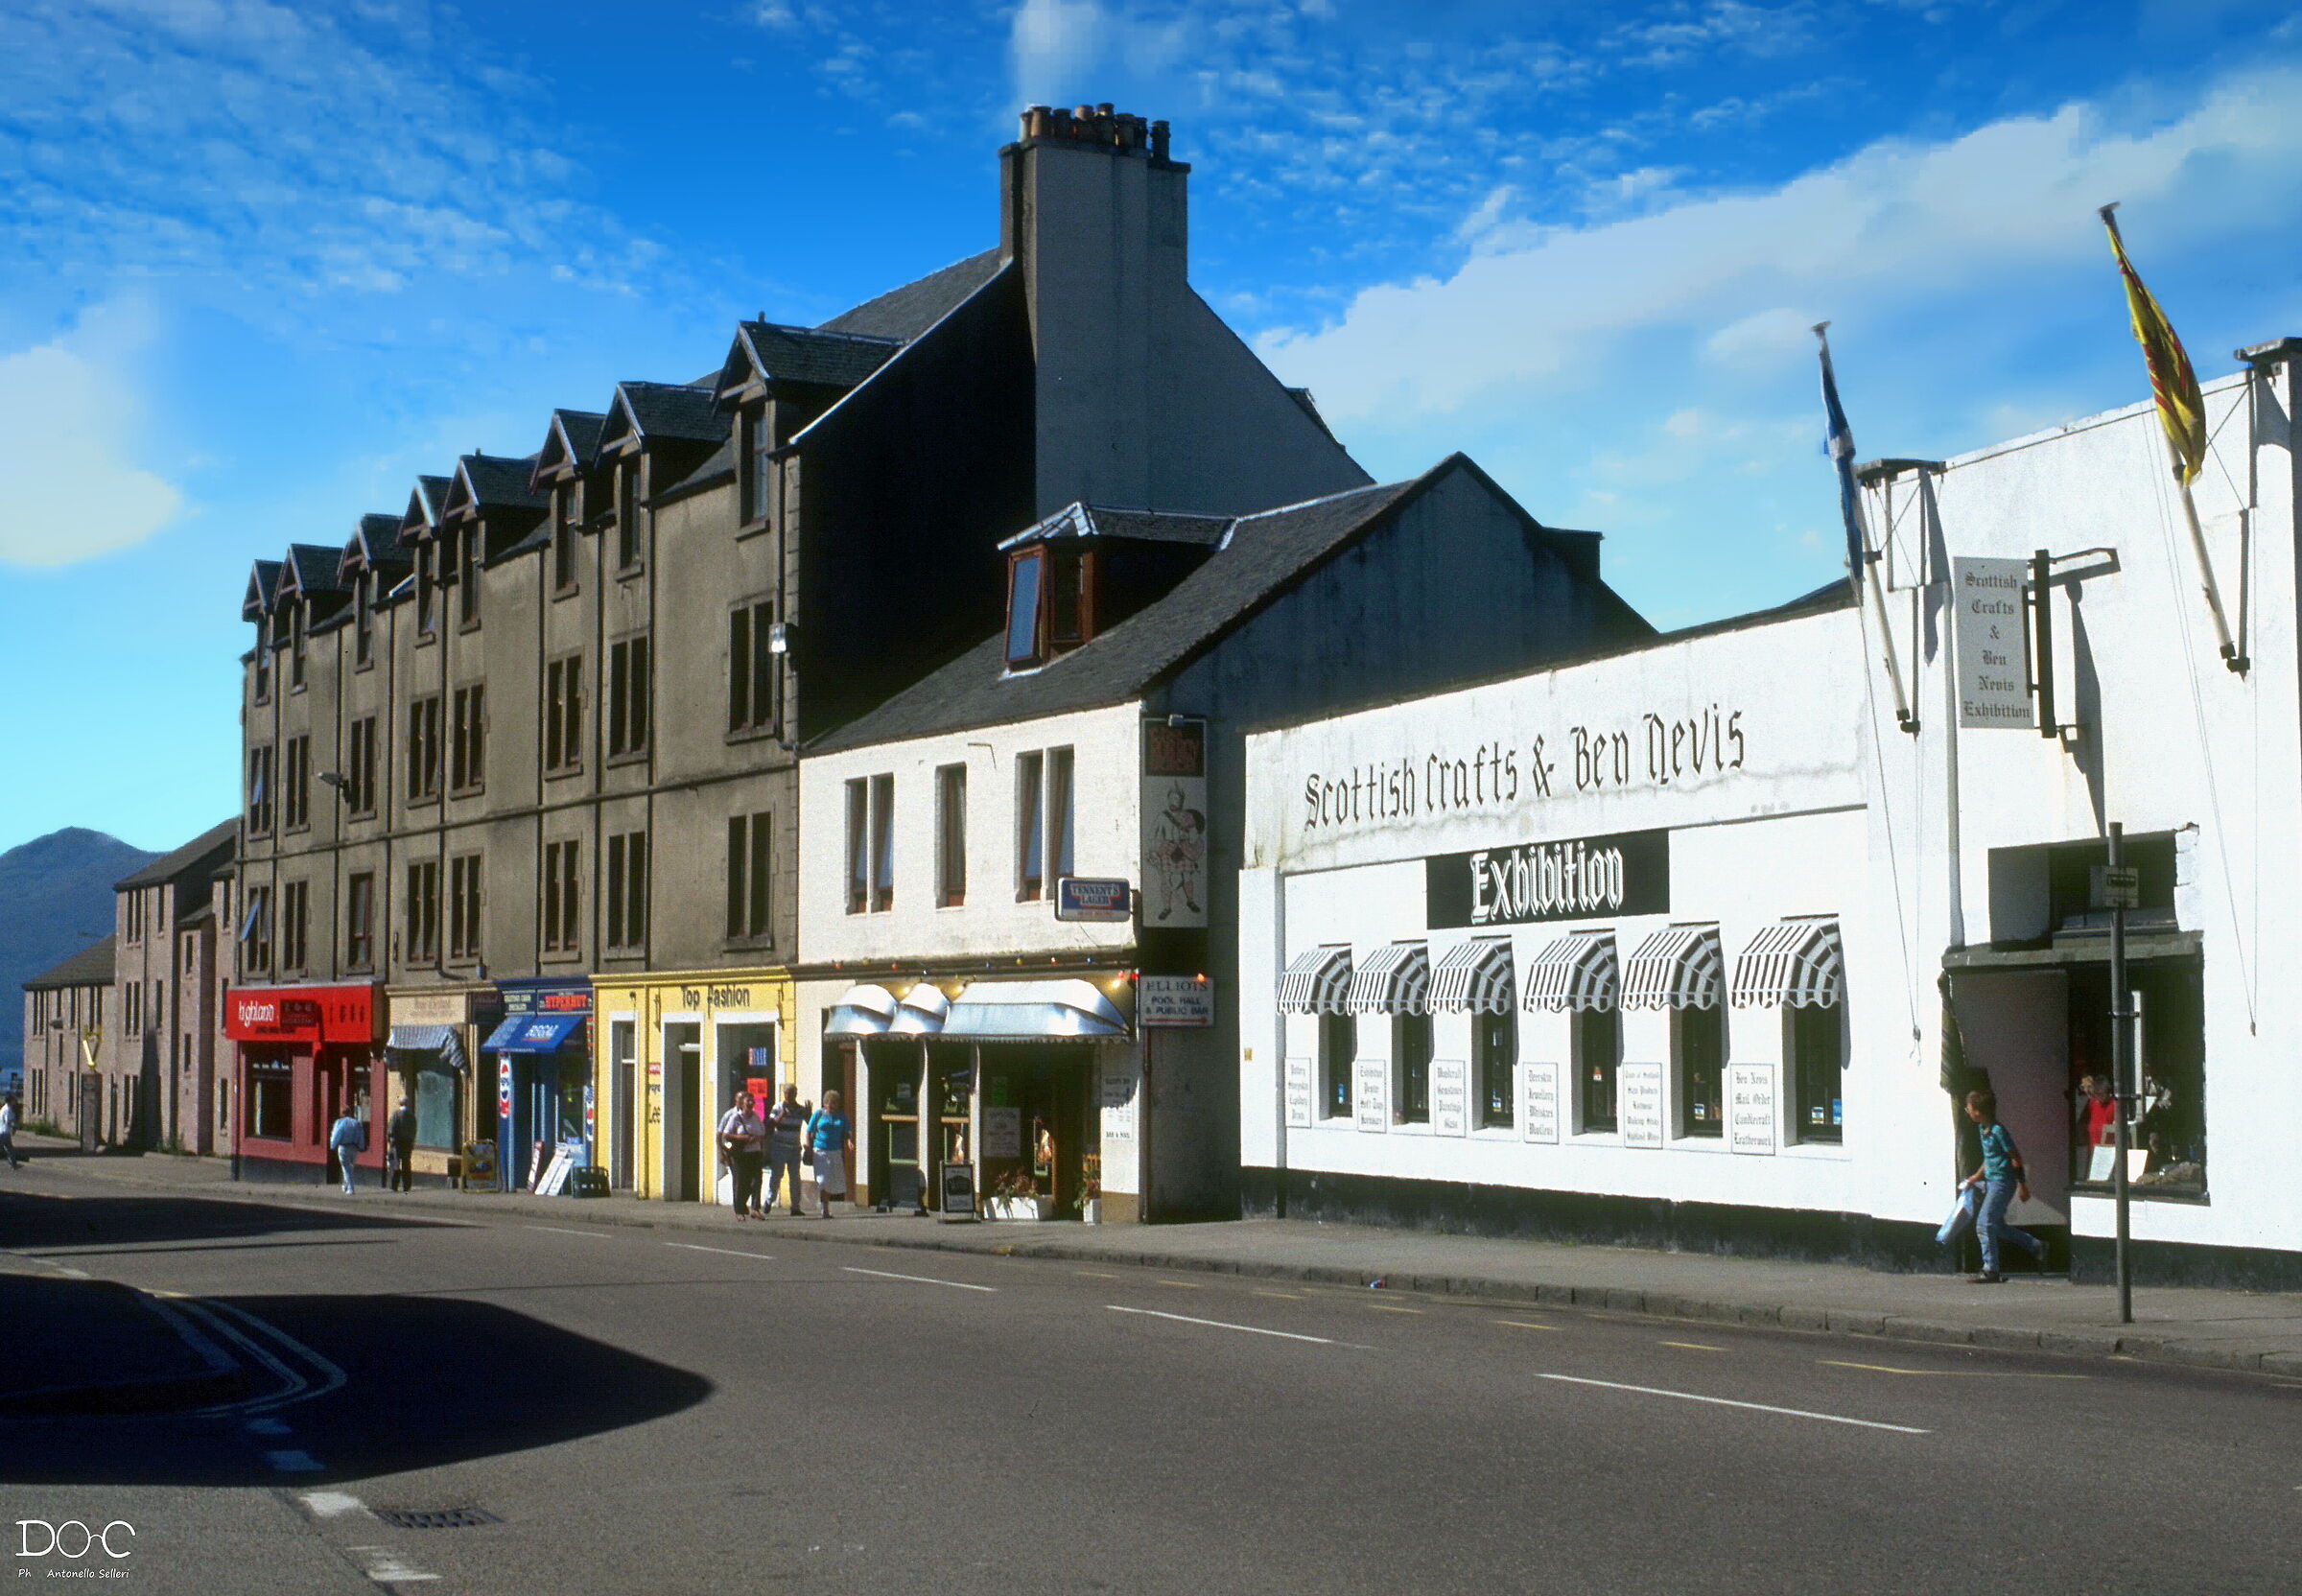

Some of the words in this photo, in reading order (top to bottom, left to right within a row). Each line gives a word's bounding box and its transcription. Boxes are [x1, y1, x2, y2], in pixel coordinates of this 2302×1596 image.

[1964, 573, 2017, 590] Scottish
[1971, 598, 2015, 615] Crafts
[1989, 625, 2000, 640] &
[1982, 649, 2007, 666] Ben
[1978, 675, 2014, 692] Nevis
[1963, 701, 2032, 719] Exhibition
[1304, 759, 1416, 833] Scottish
[1426, 741, 1517, 813] Crafts
[1532, 734, 1555, 798] &
[1571, 725, 1630, 793] Ben
[1642, 703, 1745, 786] Nevis
[1470, 840, 1625, 926] Exhibition
[681, 984, 700, 1011] Top
[1180, 996, 1201, 1004] HALL
[1156, 1006, 1187, 1015] PUBLIC
[1190, 1006, 1209, 1015] BAR
[1736, 1072, 1748, 1084] Ben
[1750, 1072, 1768, 1084] Nevis
[1735, 1092, 1750, 1104] Mail
[1752, 1092, 1771, 1105] Order
[1735, 1114, 1771, 1125] Candlecraft
[1734, 1132, 1772, 1146] Leatherwork
